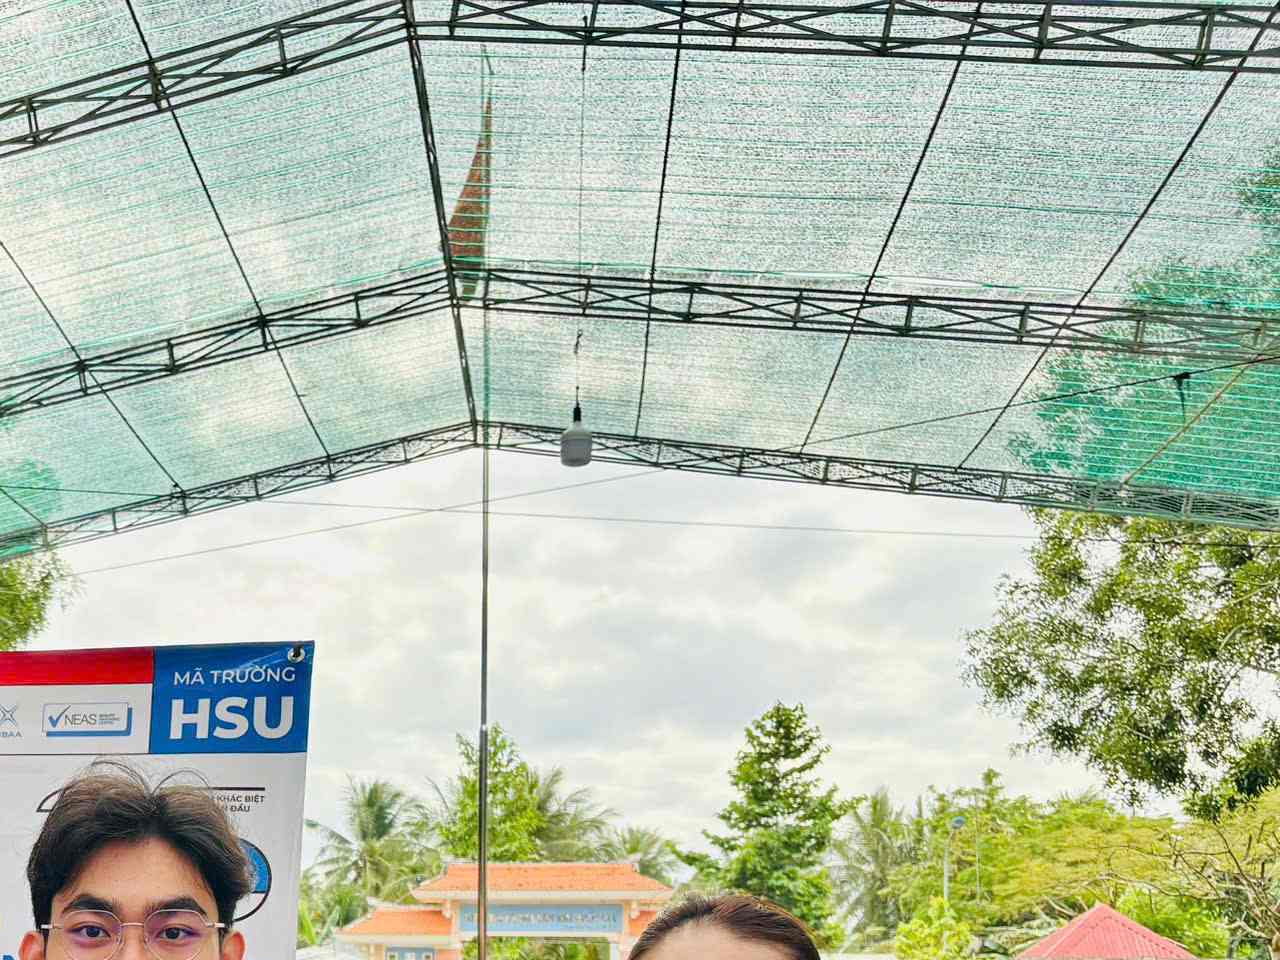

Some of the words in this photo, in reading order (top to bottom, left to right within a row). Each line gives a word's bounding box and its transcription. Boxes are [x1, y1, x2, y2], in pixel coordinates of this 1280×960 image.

[173, 667, 205, 686] MÃ
[210, 664, 297, 685] TRƯỜNG
[64, 713, 97, 726] NEAS
[169, 695, 295, 740] HSU
